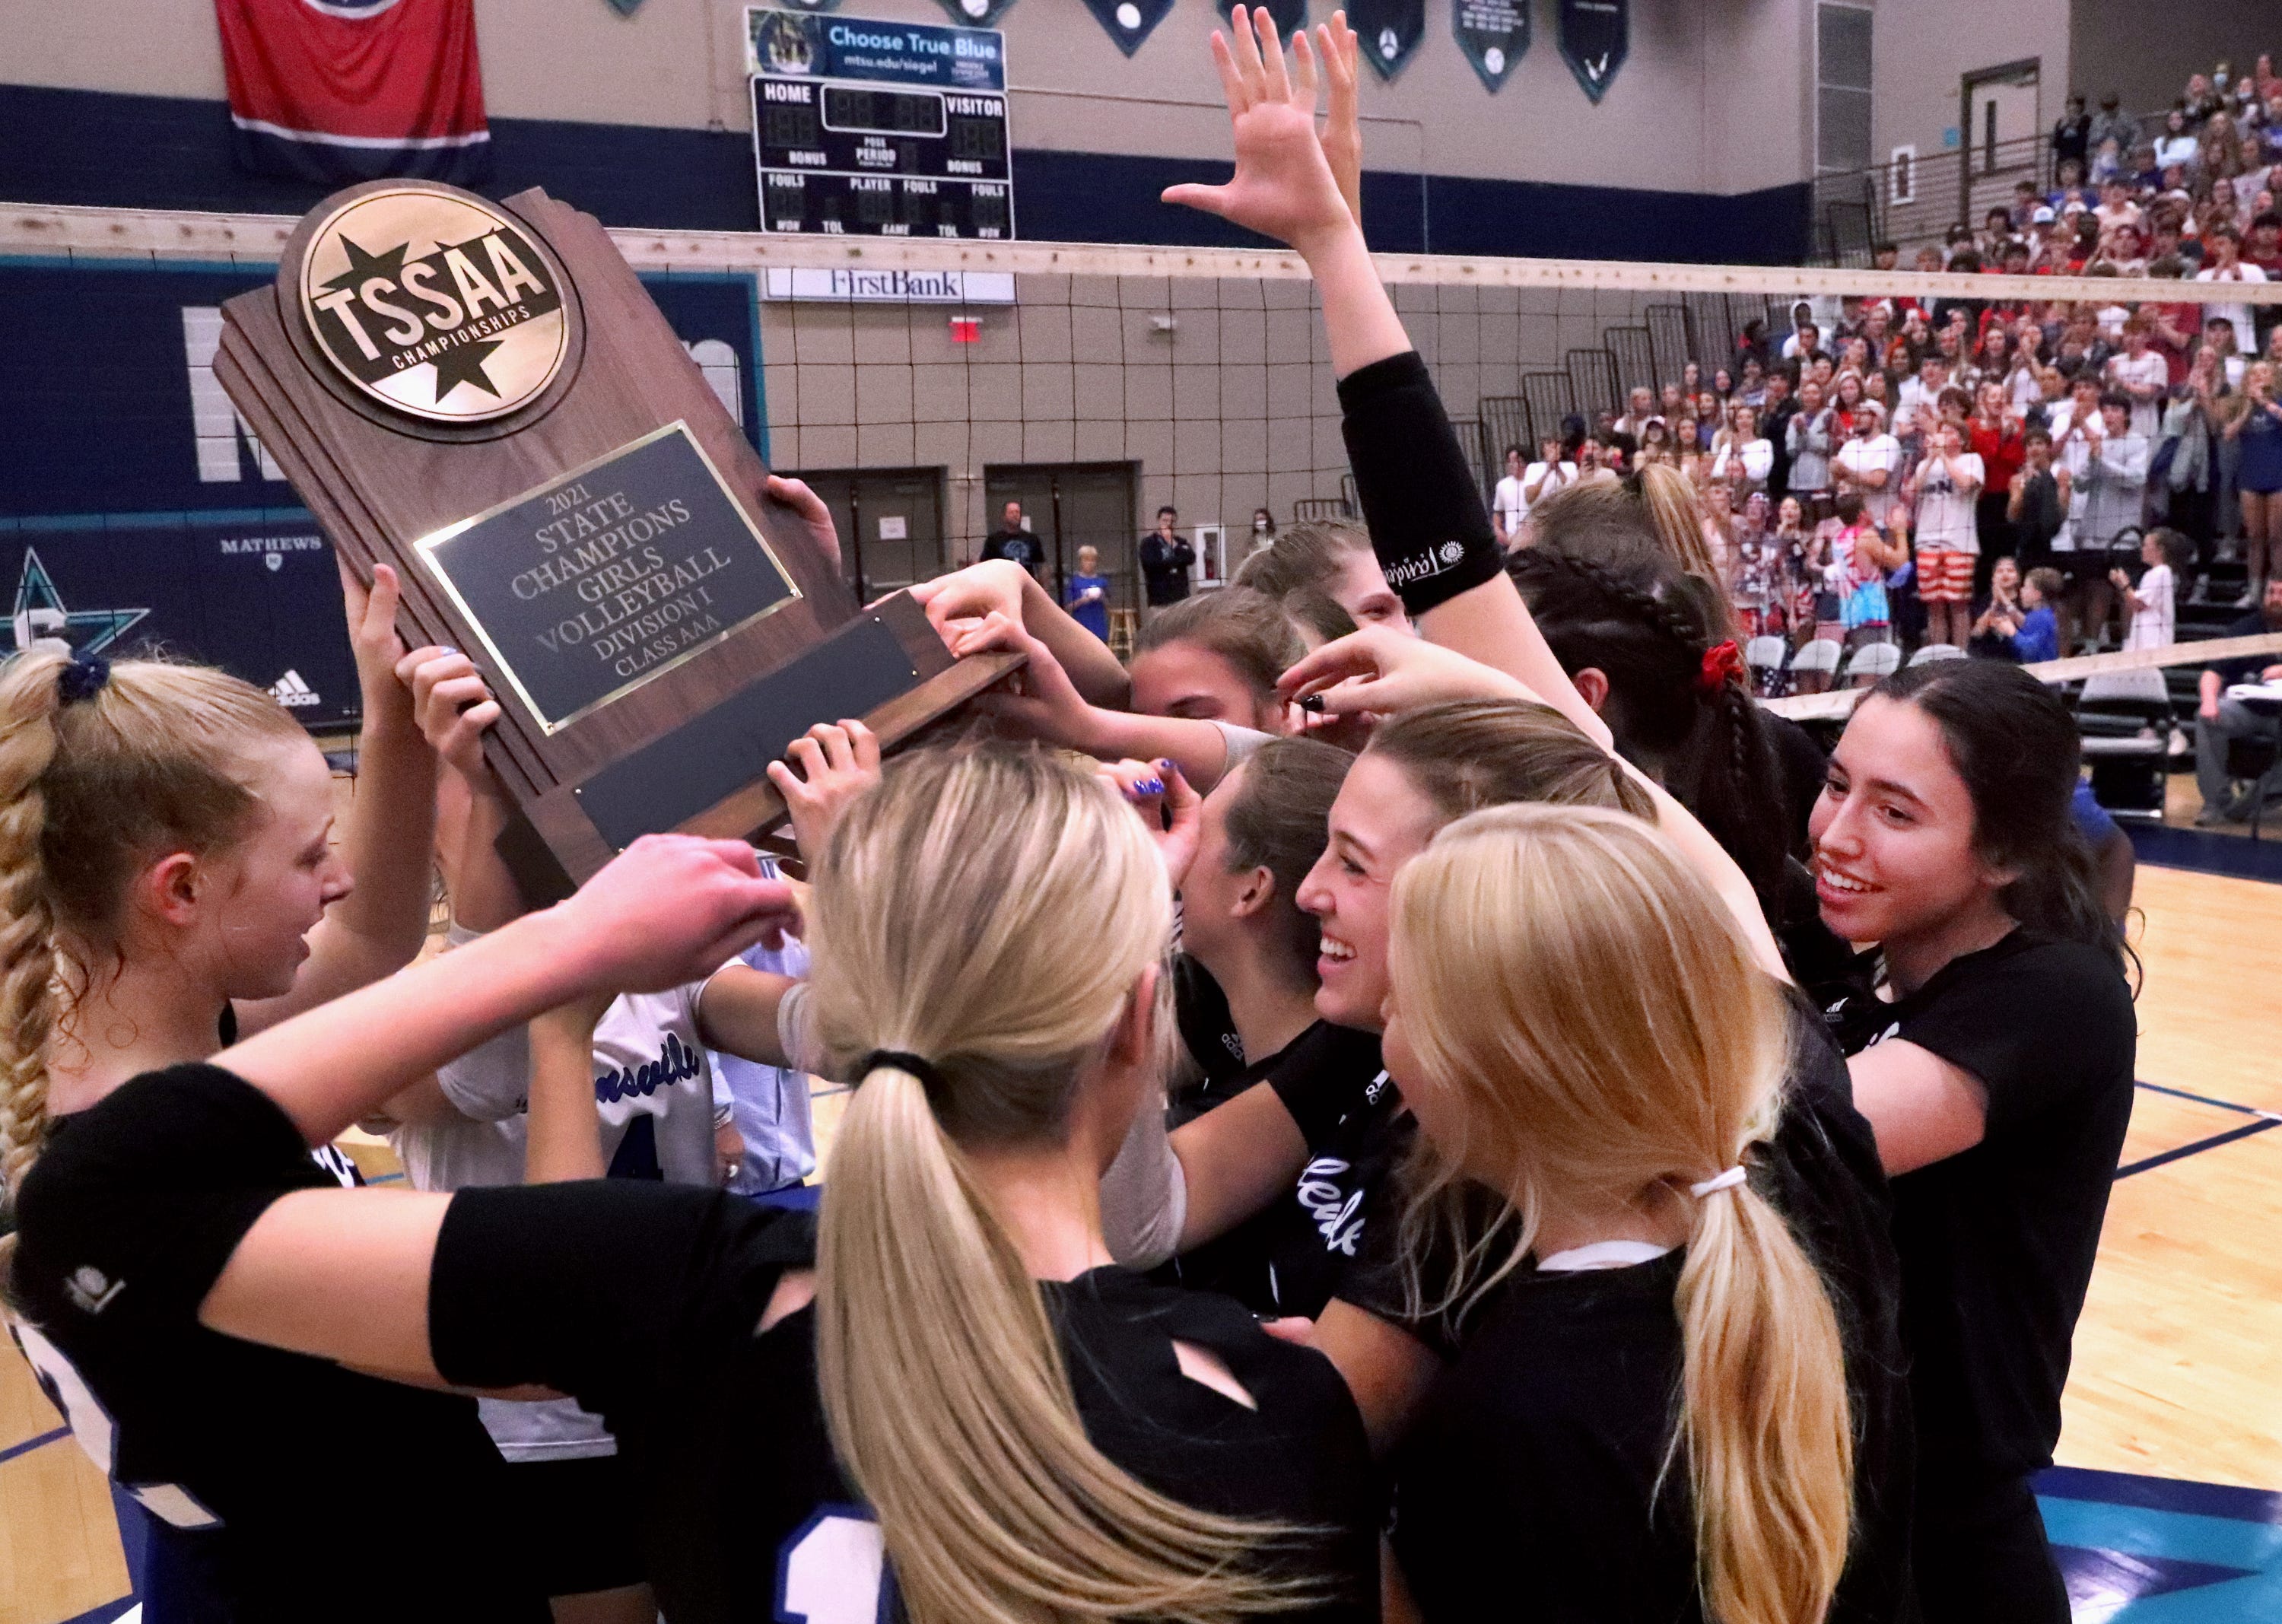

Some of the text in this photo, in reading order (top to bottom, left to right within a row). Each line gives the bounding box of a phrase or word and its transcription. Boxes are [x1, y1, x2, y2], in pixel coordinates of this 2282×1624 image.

[830, 26, 996, 59] Choose True Blue
[764, 83, 1003, 116] HOME VISITOR
[789, 151, 827, 166] BONUS
[855, 147, 896, 162] PERIOD
[947, 160, 983, 174] BONUS
[768, 173, 805, 188] FOULS
[850, 177, 937, 193] PLAYER FOULS
[971, 184, 1004, 197] FOULS
[315, 234, 546, 361] TSSAA
[831, 270, 960, 297] FirstBank
[392, 306, 531, 370] CHAMPIONSHIPS
[546, 484, 593, 516] 2021
[535, 491, 635, 554] STATE
[221, 536, 322, 553] MATHEWS
[511, 498, 691, 600] CHAMPIONS
[577, 547, 664, 602] GIRLS
[535, 545, 732, 653] VOLLEYBALL
[591, 586, 714, 661] DIVISION I
[615, 615, 721, 677] CLASS AAA
